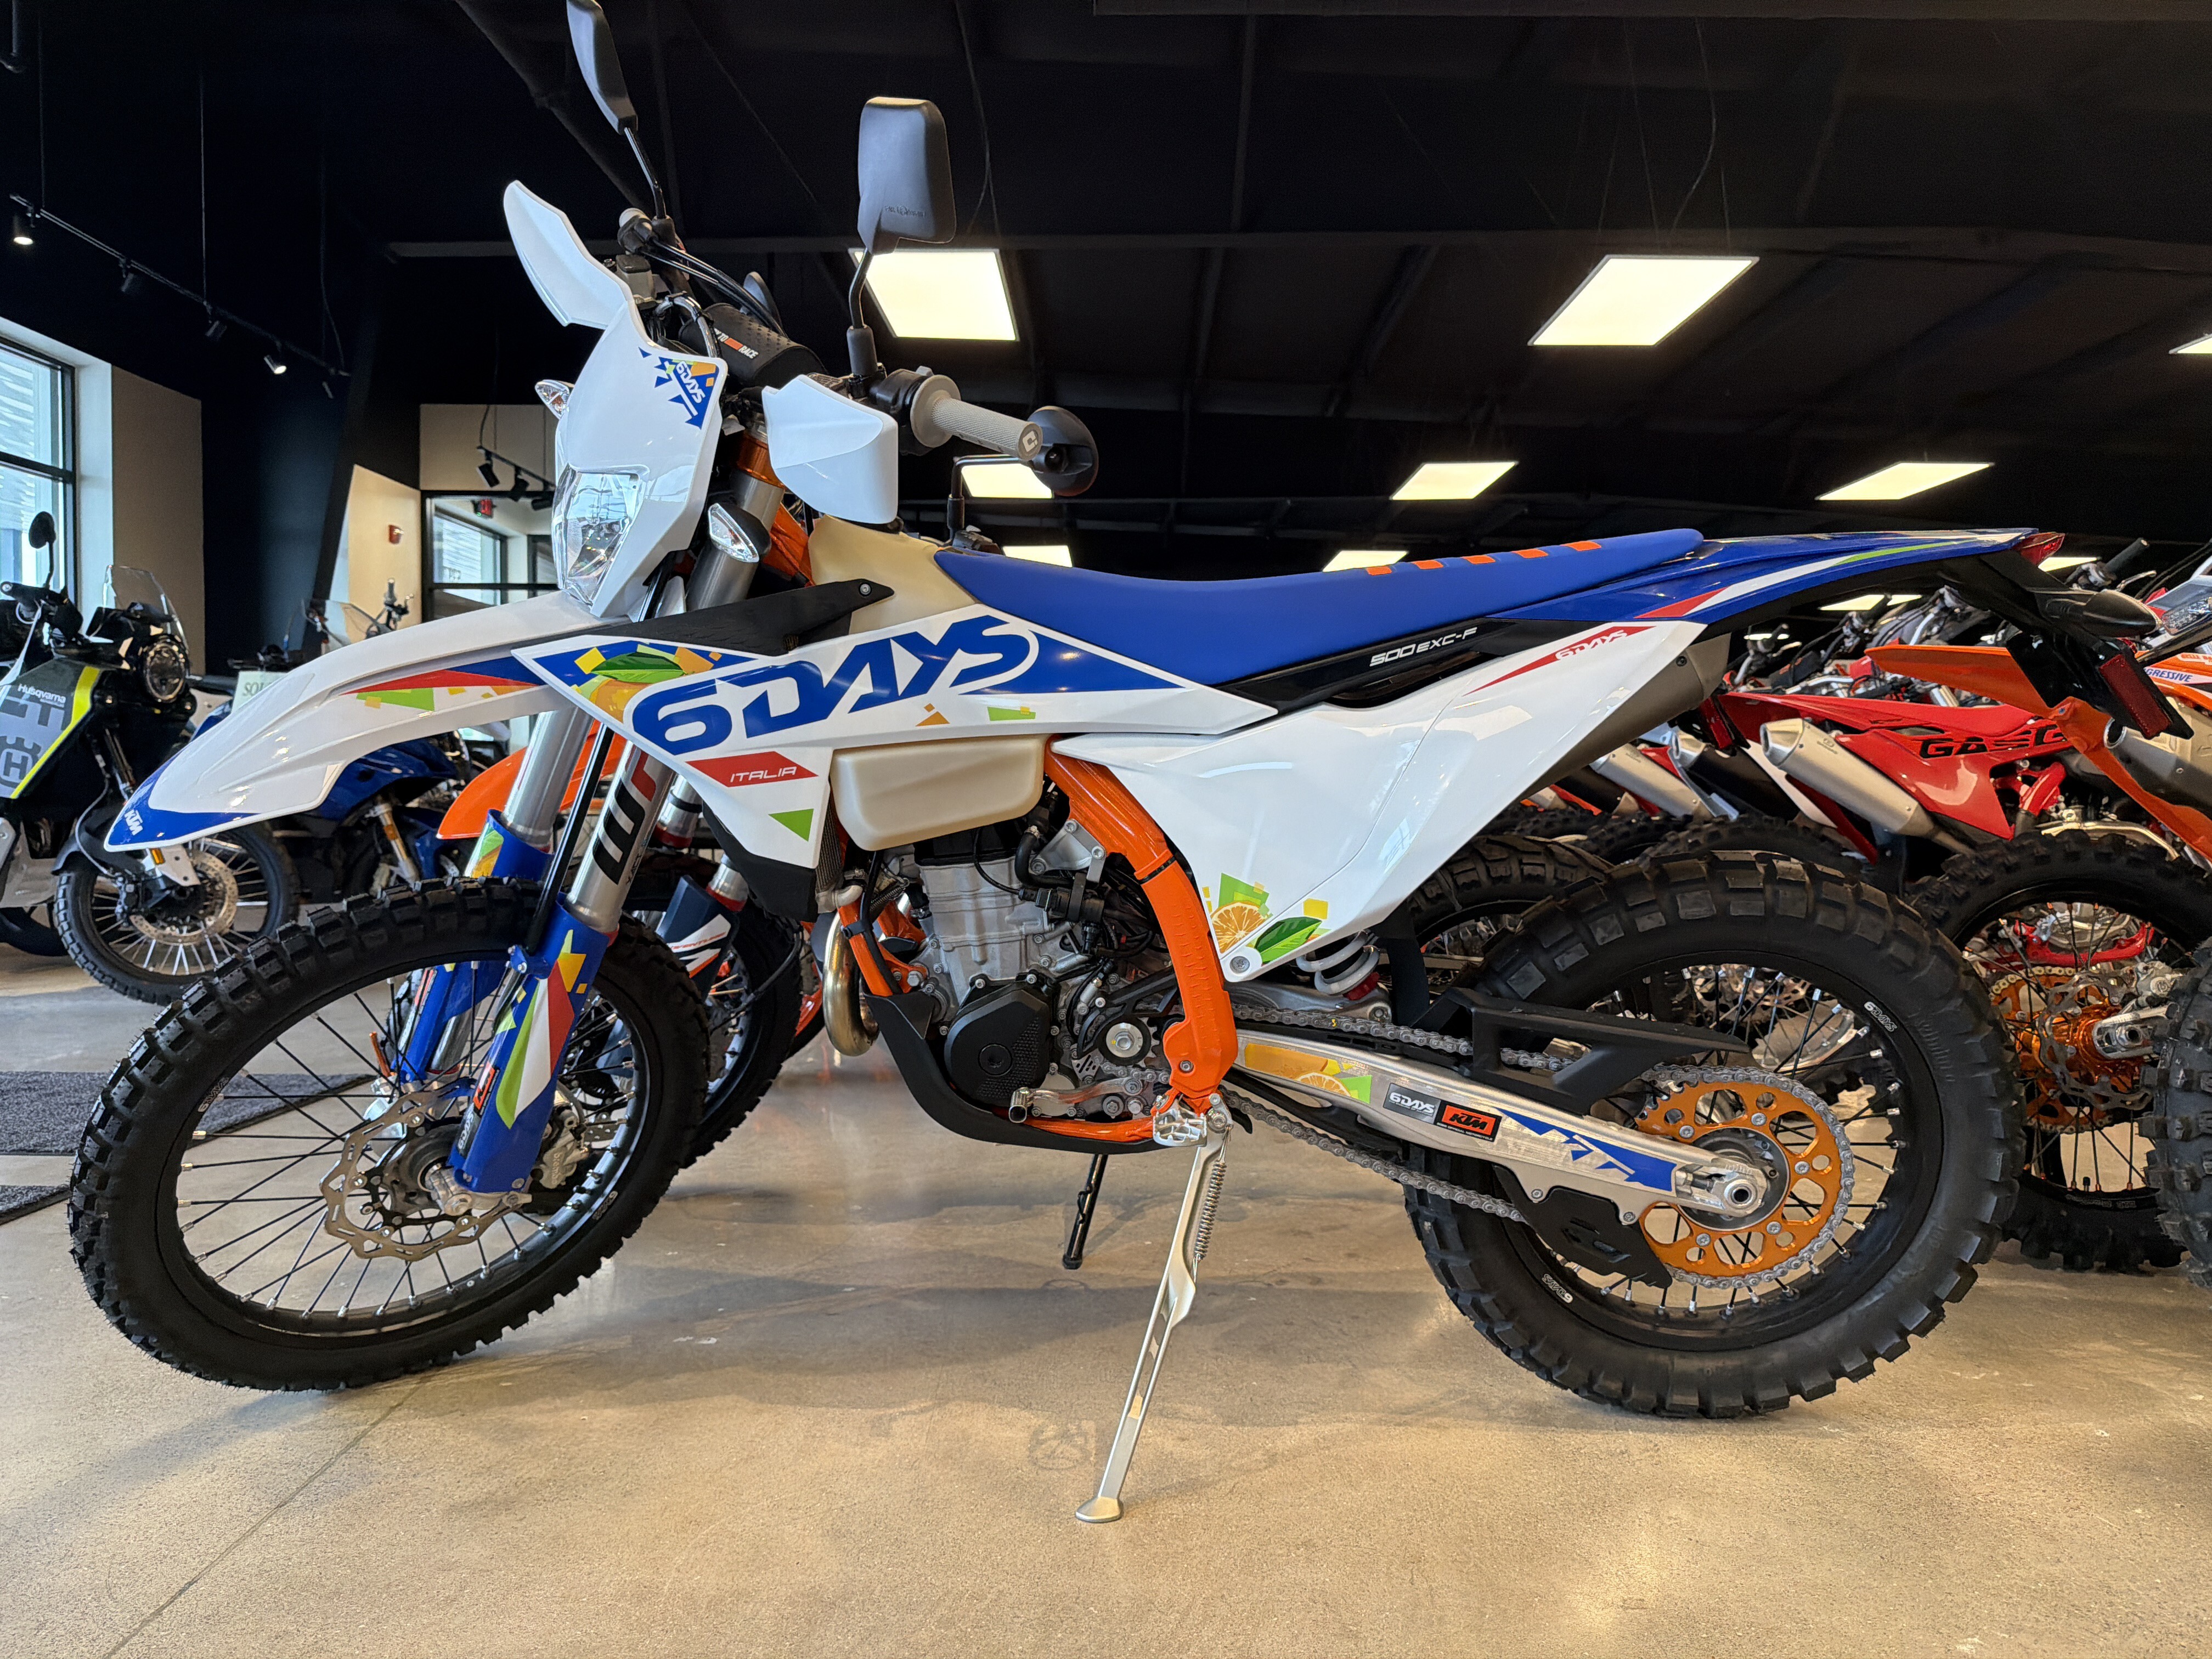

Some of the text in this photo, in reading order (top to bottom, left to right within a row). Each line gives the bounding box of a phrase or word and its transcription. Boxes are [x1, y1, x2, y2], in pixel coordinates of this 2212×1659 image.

[718, 332, 759, 359] TO RACE
[676, 361, 706, 403] 6DAYS
[633, 615, 1030, 755] 6DAYS
[2144, 668, 2193, 682] GRESSIVE
[18, 684, 66, 704] Husqvarna
[730, 766, 797, 783] ITALIA
[125, 809, 143, 836] KTM
[1864, 1001, 1898, 1032] 6DAYS
[1389, 1091, 1436, 1114] 6DAYS
[1448, 1112, 1489, 1131] KTM
[1542, 1273, 1573, 1304] 6DAYS
